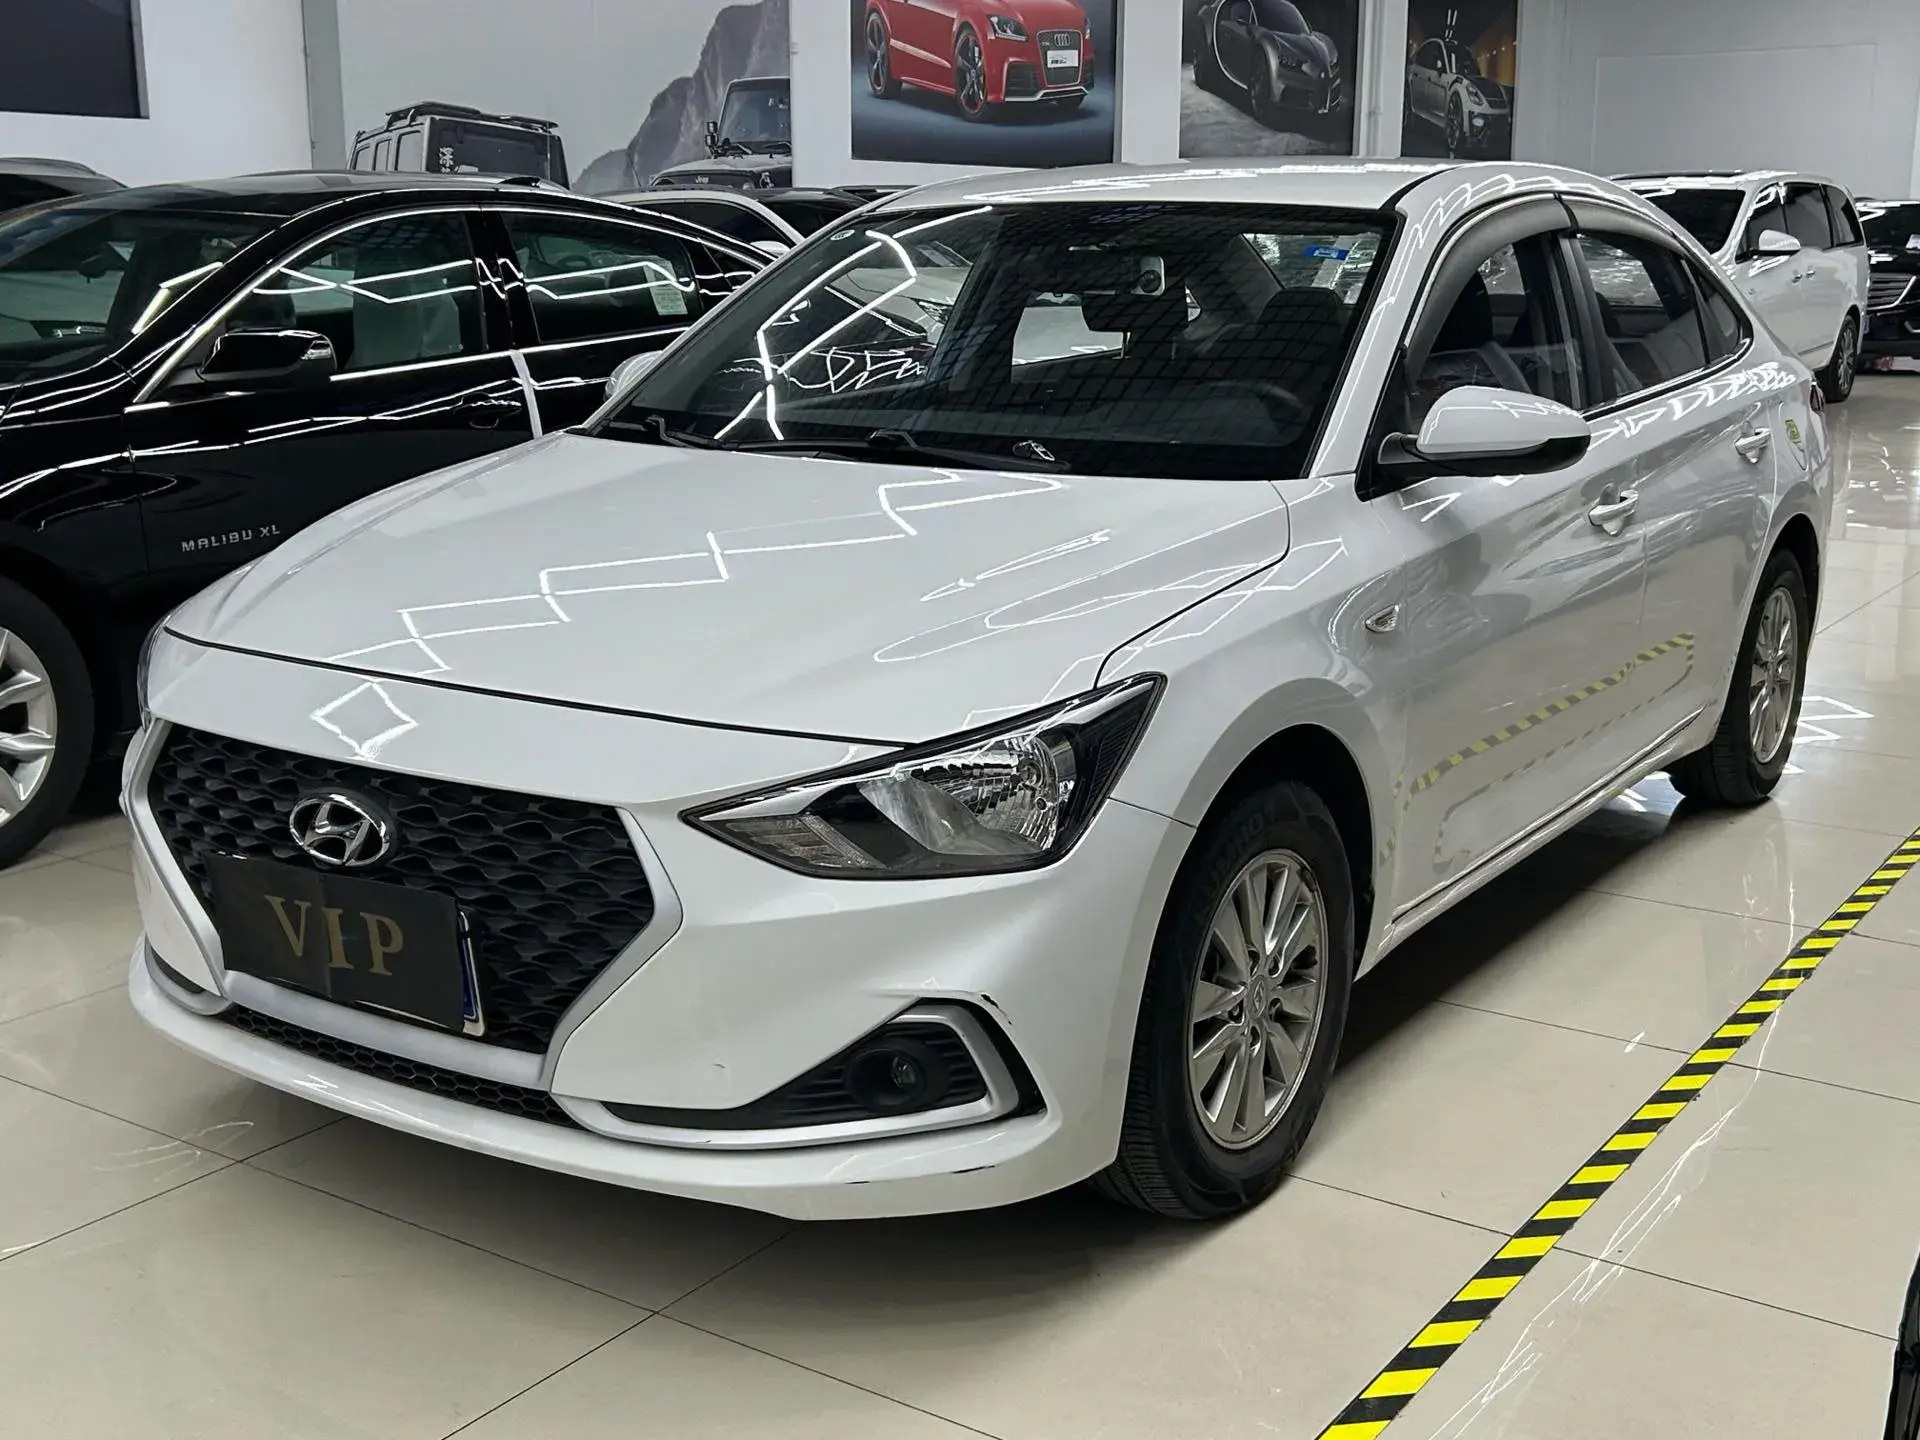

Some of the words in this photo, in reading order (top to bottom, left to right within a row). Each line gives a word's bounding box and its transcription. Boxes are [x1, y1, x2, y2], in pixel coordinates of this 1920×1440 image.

[180, 529, 253, 553] MALIBU
[259, 524, 281, 539] XL
[264, 895, 404, 976] VIP
